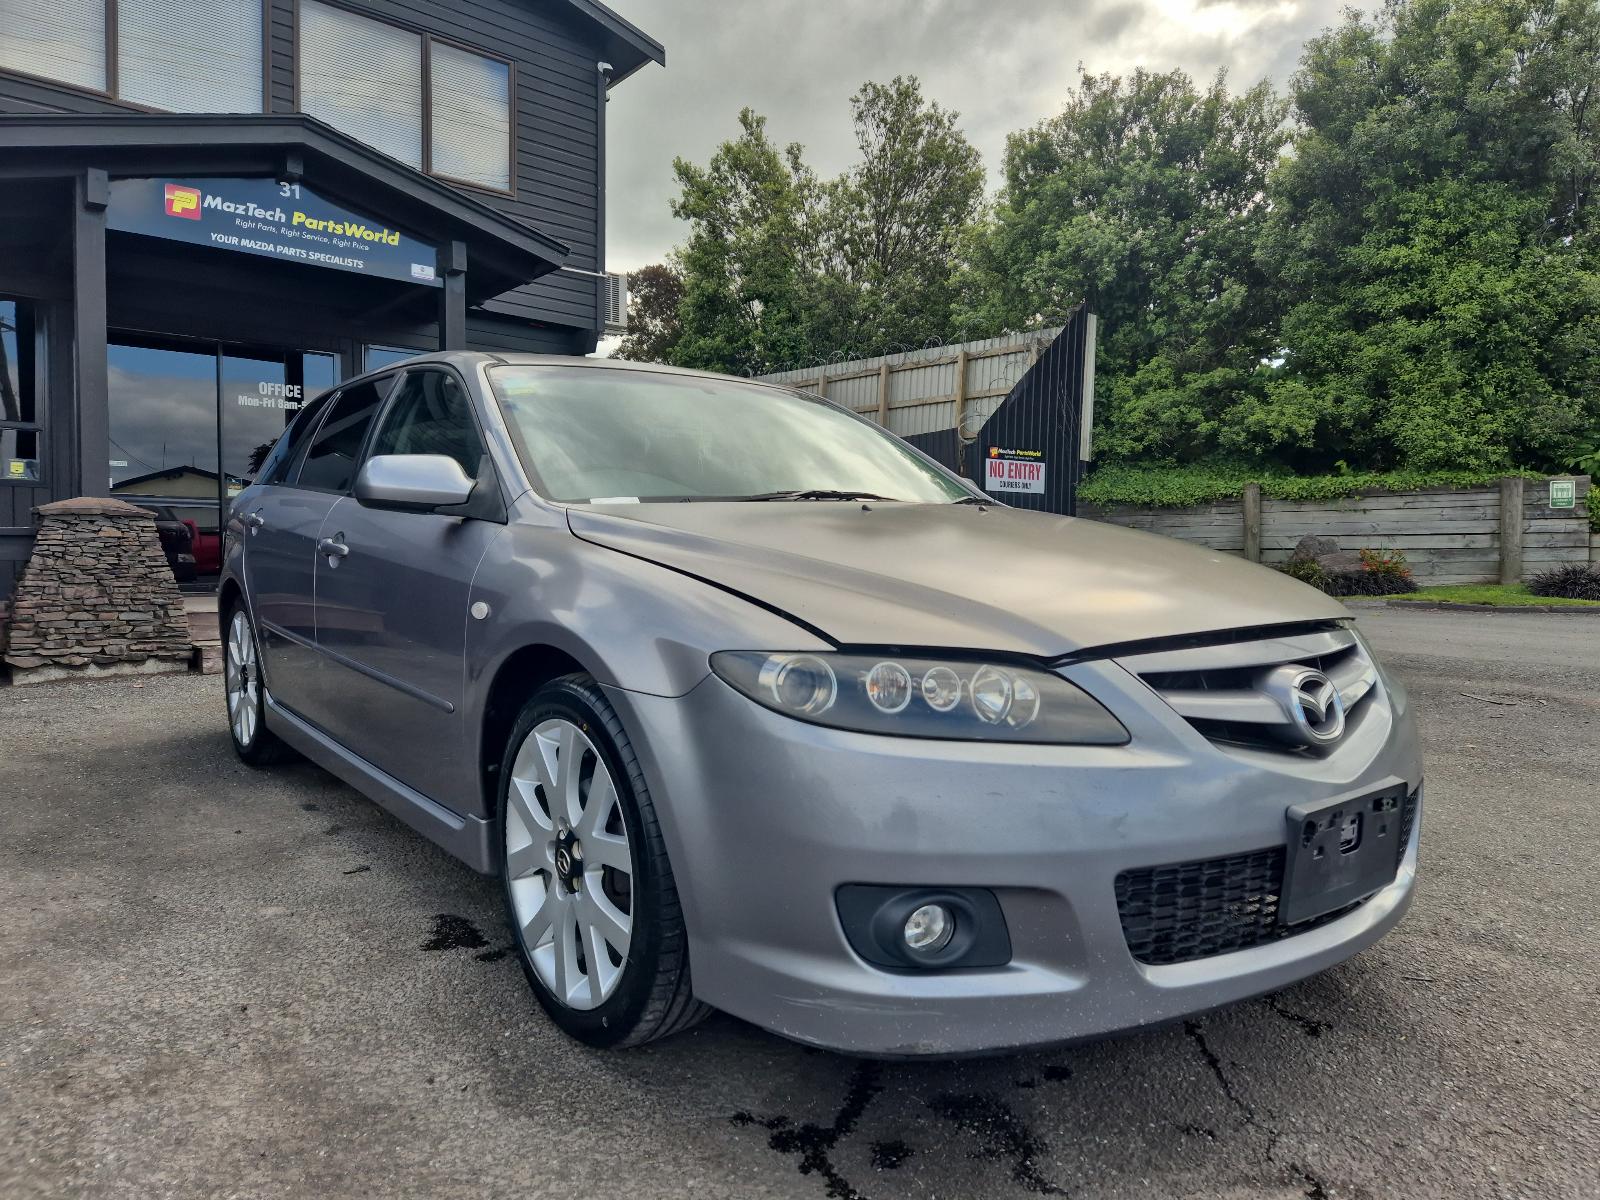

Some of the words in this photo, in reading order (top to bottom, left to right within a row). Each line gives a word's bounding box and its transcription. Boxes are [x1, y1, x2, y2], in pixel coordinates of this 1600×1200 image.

[280, 182, 300, 199] 31
[203, 194, 286, 222] MazTech
[292, 211, 400, 246] PartsWorld
[235, 218, 256, 230] Right
[257, 222, 278, 234] Parts,
[281, 226, 301, 238] Right
[302, 231, 330, 244] Service,
[332, 237, 351, 249] Right
[352, 241, 370, 251] Price
[211, 232, 239, 246] YOUR
[241, 238, 275, 253] MAZDA
[276, 245, 307, 259] PARTS
[308, 251, 364, 269] SPECIALISTS
[259, 382, 301, 398] OFFICE
[238, 395, 275, 408] Mon-Fri
[989, 461, 1004, 478] NO
[1008, 462, 1041, 480] ENTRY
